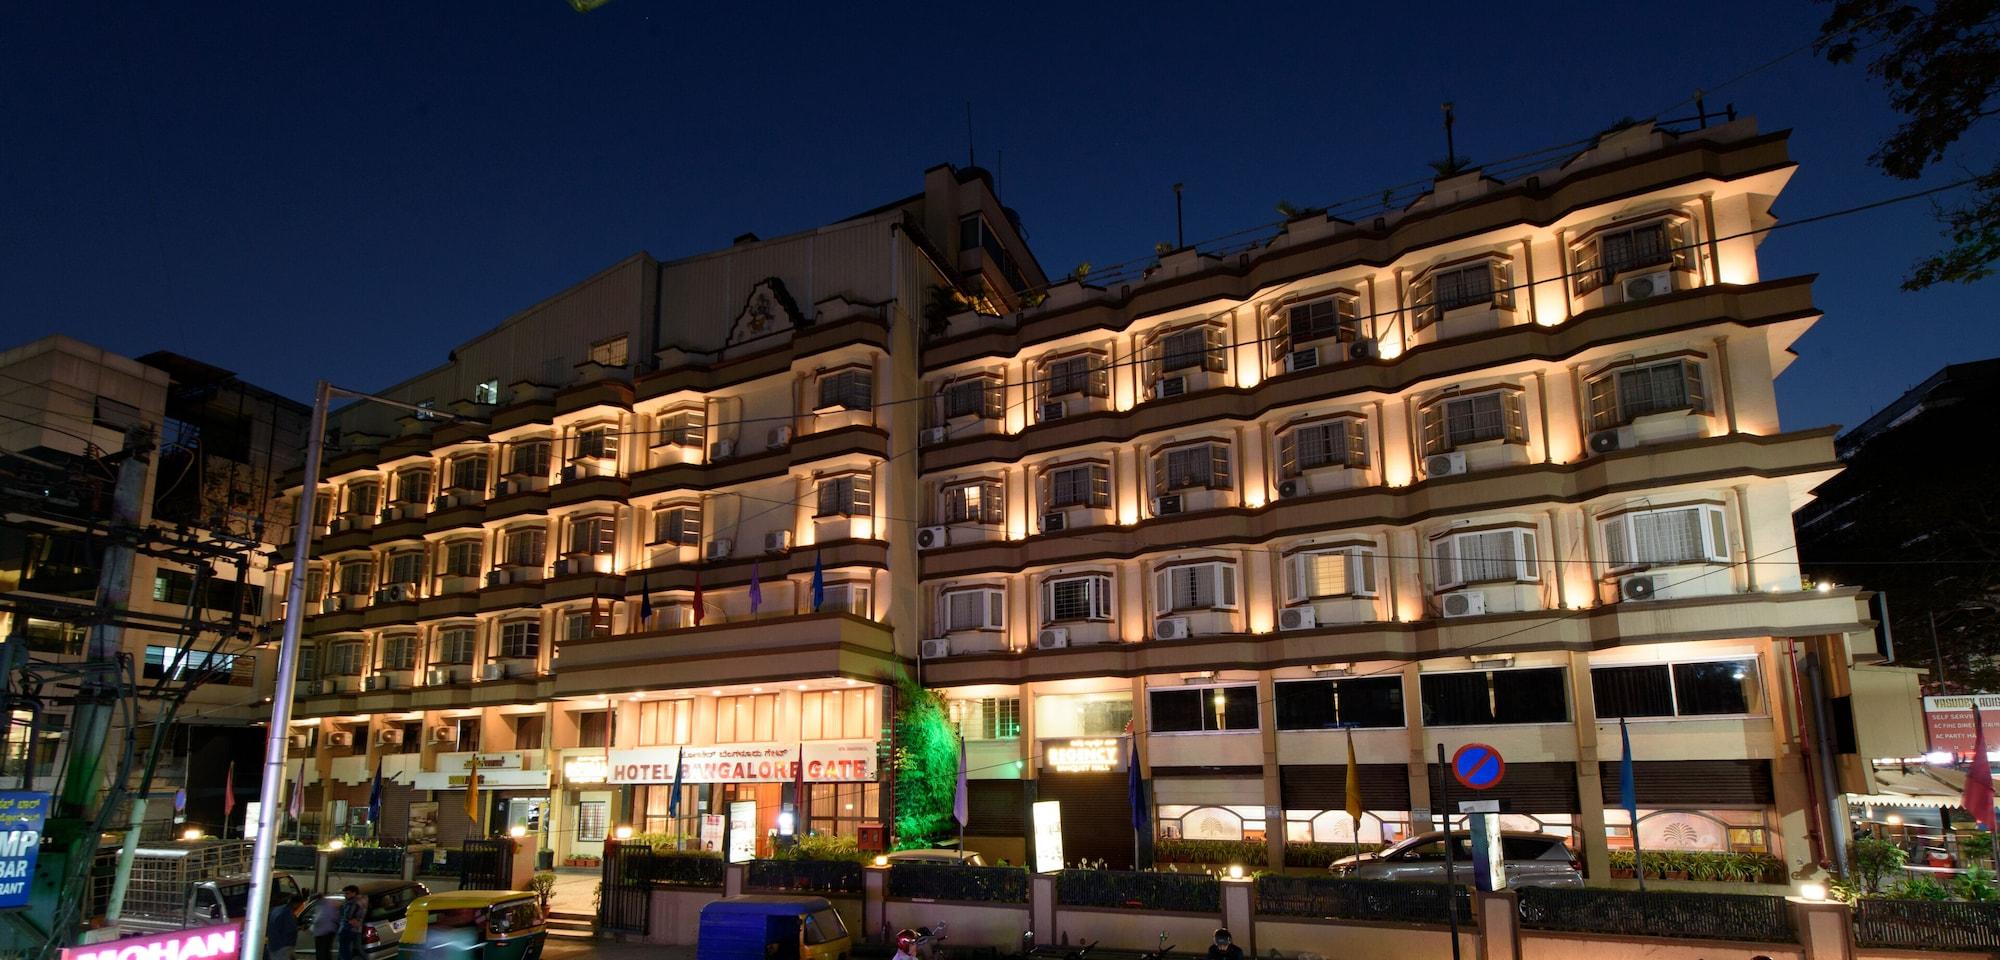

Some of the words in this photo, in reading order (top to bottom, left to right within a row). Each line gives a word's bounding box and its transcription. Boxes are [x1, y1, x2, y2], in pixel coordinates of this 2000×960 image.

[614, 764, 673, 780] HOTEL
[681, 761, 801, 780] BANGALORE
[808, 759, 866, 778] GATE
